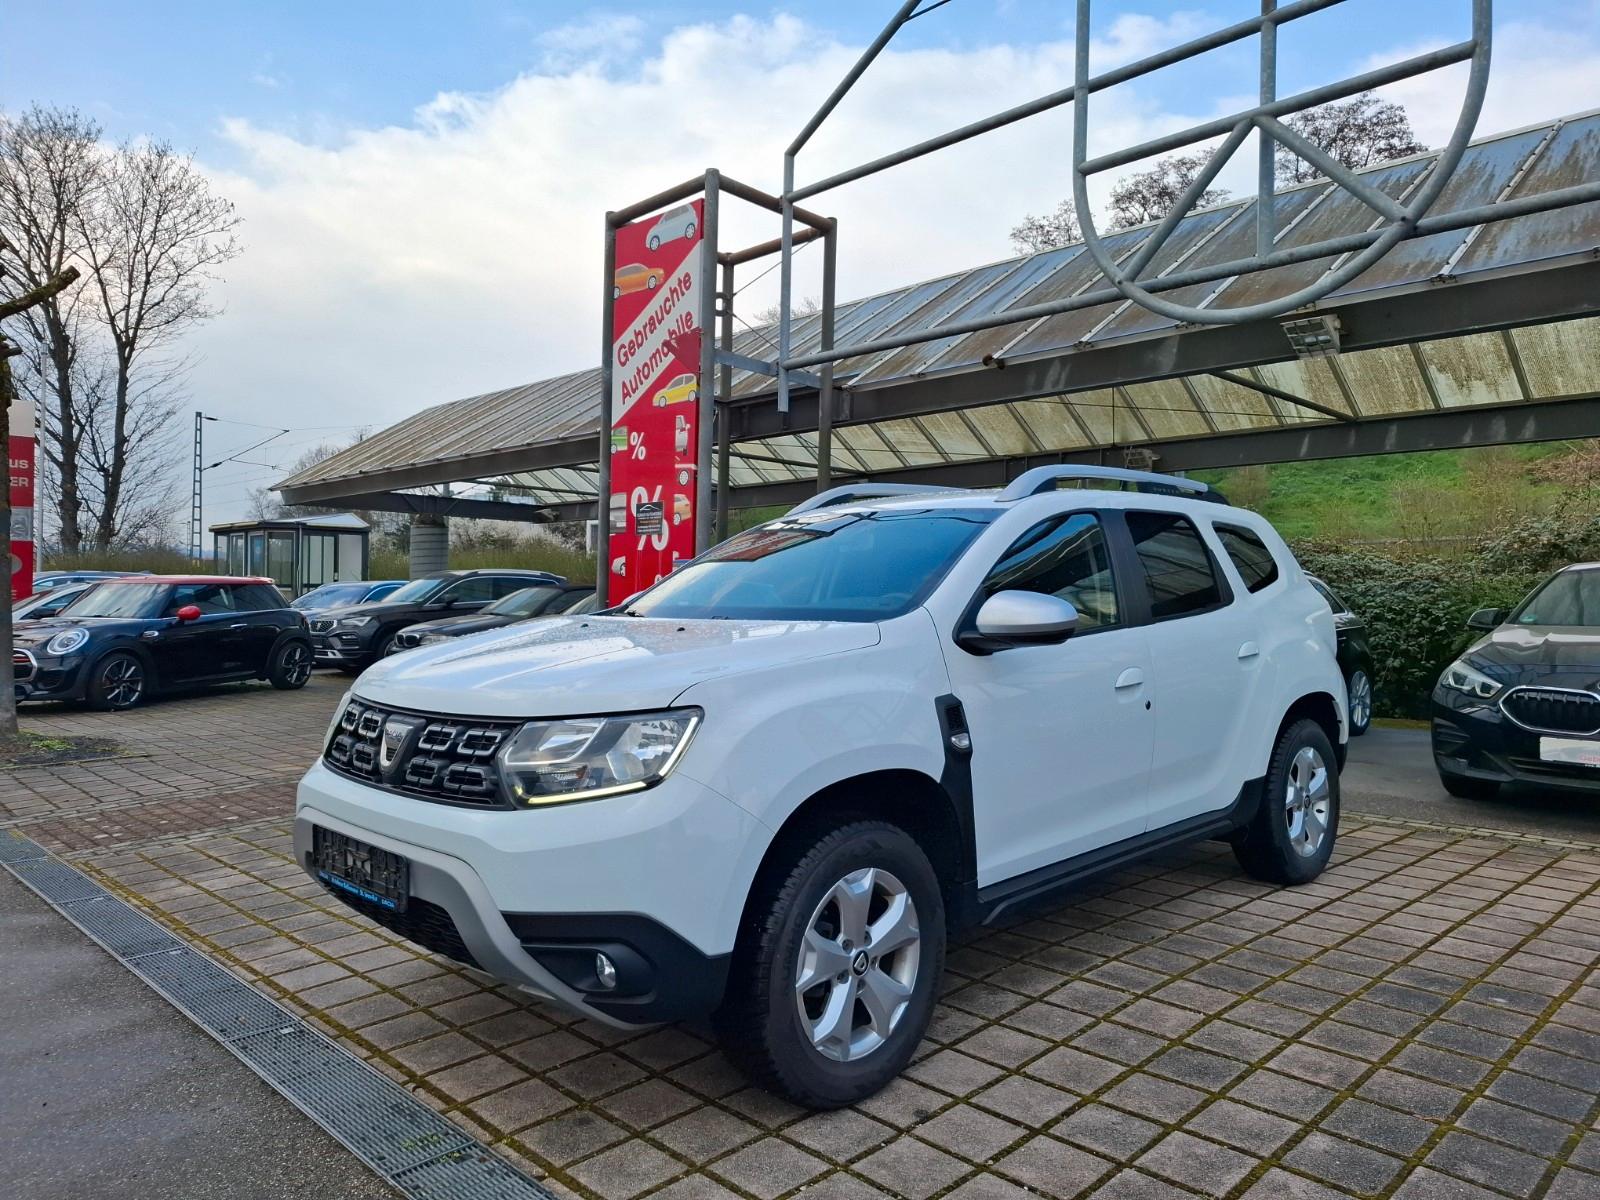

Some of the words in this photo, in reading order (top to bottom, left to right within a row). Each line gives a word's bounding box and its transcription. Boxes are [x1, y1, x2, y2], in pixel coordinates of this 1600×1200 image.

[617, 271, 692, 368] Gebrauchte
[9, 458, 29, 469] us
[10, 476, 29, 487] ER
